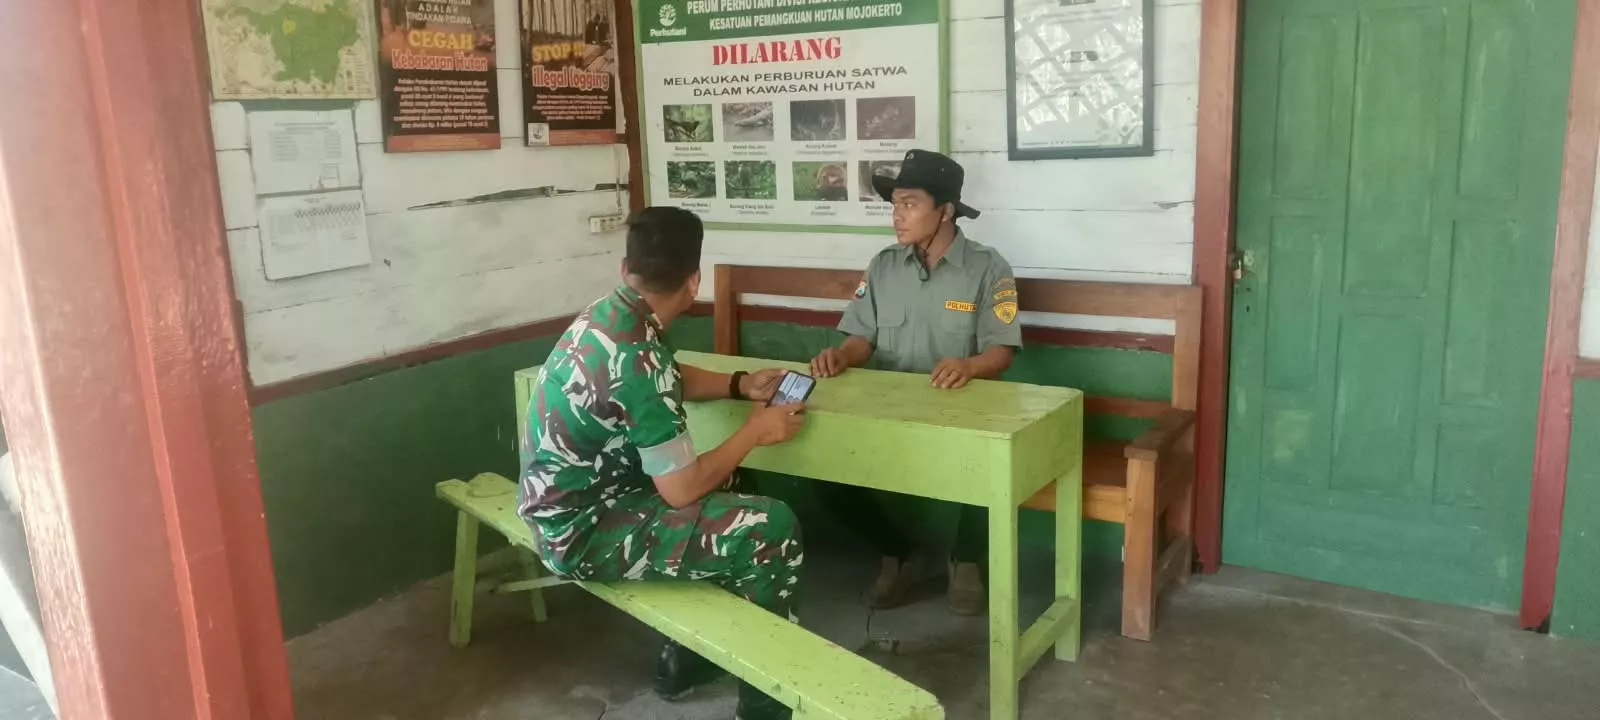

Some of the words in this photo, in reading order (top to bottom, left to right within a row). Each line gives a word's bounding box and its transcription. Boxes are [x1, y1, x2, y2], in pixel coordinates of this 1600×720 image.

[418, 3, 459, 14] ADALAH
[687, 0, 719, 14] PERUM
[709, 15, 752, 31] KESATUAN
[754, 10, 812, 27] PEMANGKUAN
[814, 8, 844, 22] HUTAN
[846, 3, 902, 19] MOJOKERTO
[408, 29, 474, 50] CEGAH
[650, 27, 687, 37] Perhutani
[391, 48, 454, 71] Kebakaran
[455, 50, 488, 71] Hutan
[533, 44, 571, 61] STOP
[712, 37, 841, 65] DILARANG
[532, 65, 568, 91] illegal
[569, 66, 609, 91] logging
[663, 74, 750, 86] MELAKUKAN
[754, 70, 847, 83] PERBURUAN
[851, 66, 908, 77] SATWA
[693, 87, 742, 97] DALAM
[748, 84, 819, 95] KAWASAN
[823, 80, 876, 91] HUTAN
